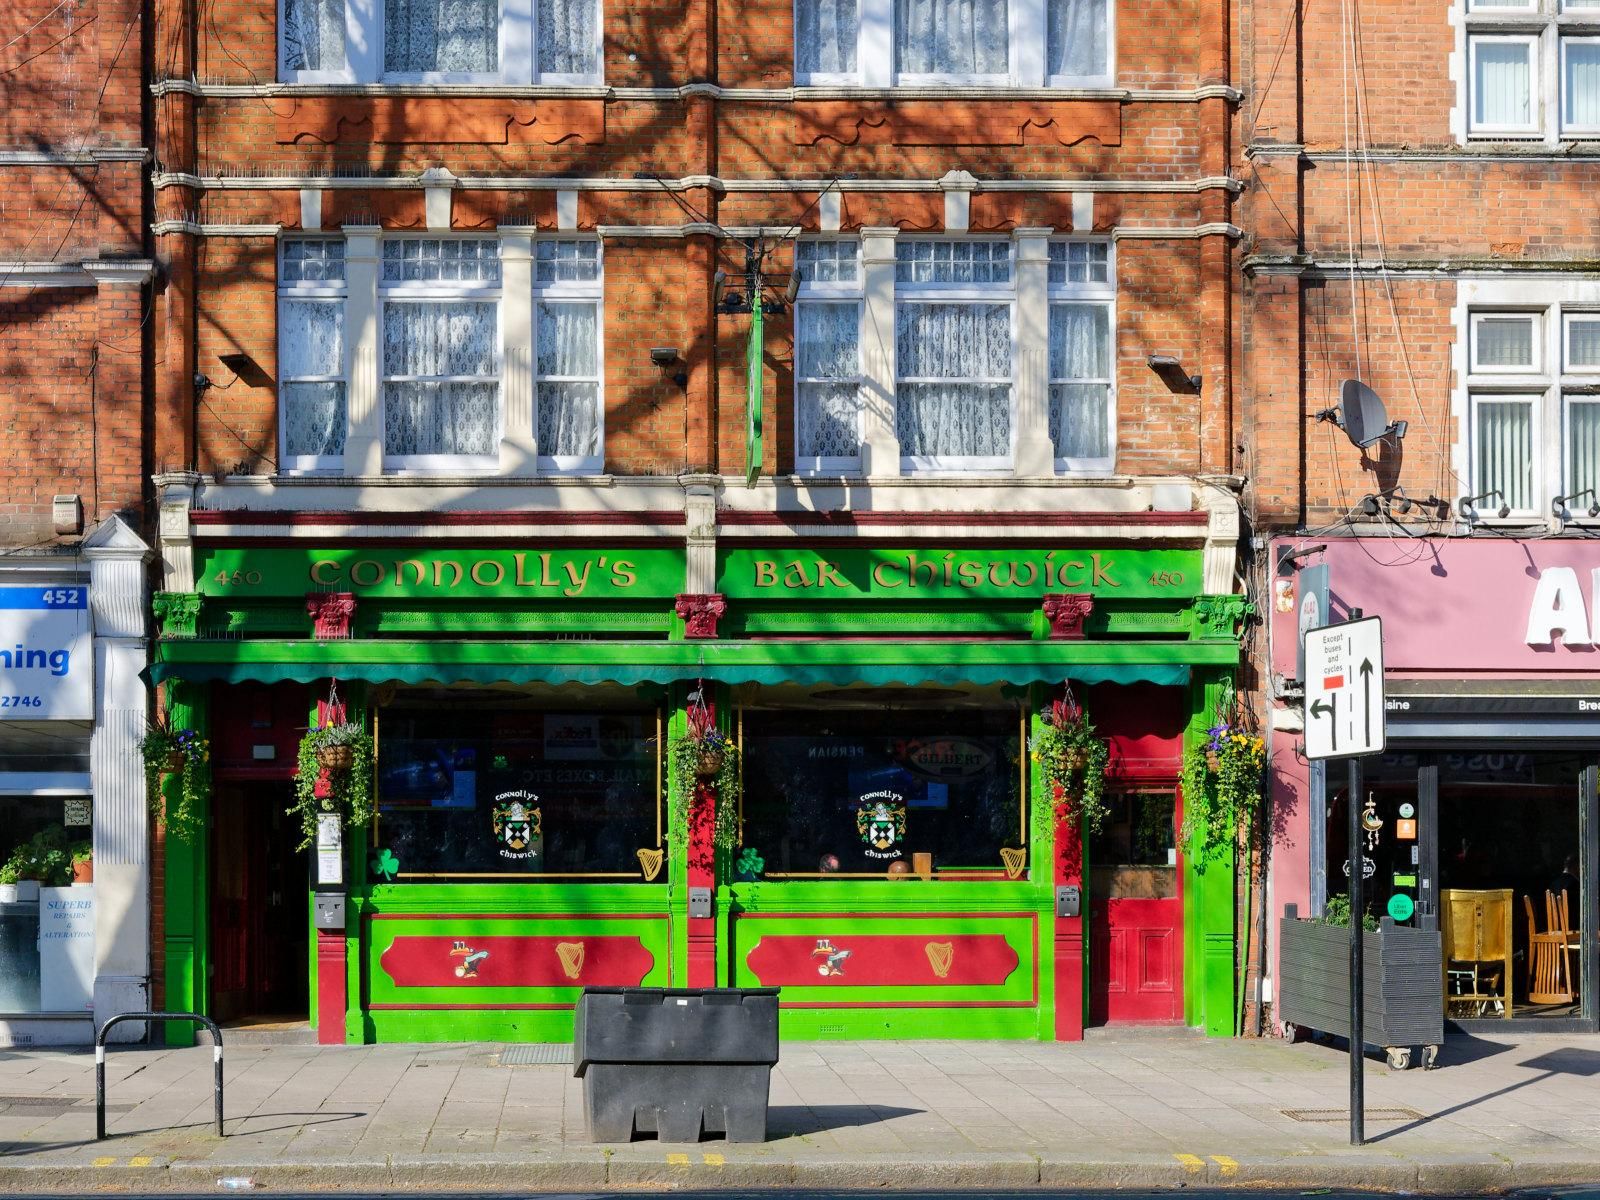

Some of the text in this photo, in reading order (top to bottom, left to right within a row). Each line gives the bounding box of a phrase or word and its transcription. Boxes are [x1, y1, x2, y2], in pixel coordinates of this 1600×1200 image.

[214, 569, 263, 587] 450
[753, 559, 850, 588] BAR
[1147, 571, 1185, 587] 450
[42, 589, 79, 604] 452
[1322, 633, 1344, 644] Except
[1324, 645, 1342, 654] buses
[1327, 654, 1339, 664] and
[1323, 664, 1343, 675] cycles
[1, 696, 42, 708] 2746
[918, 753, 983, 765] GILBERT
[47, 900, 92, 910] SUPERB
[53, 912, 87, 920] REPAIRS
